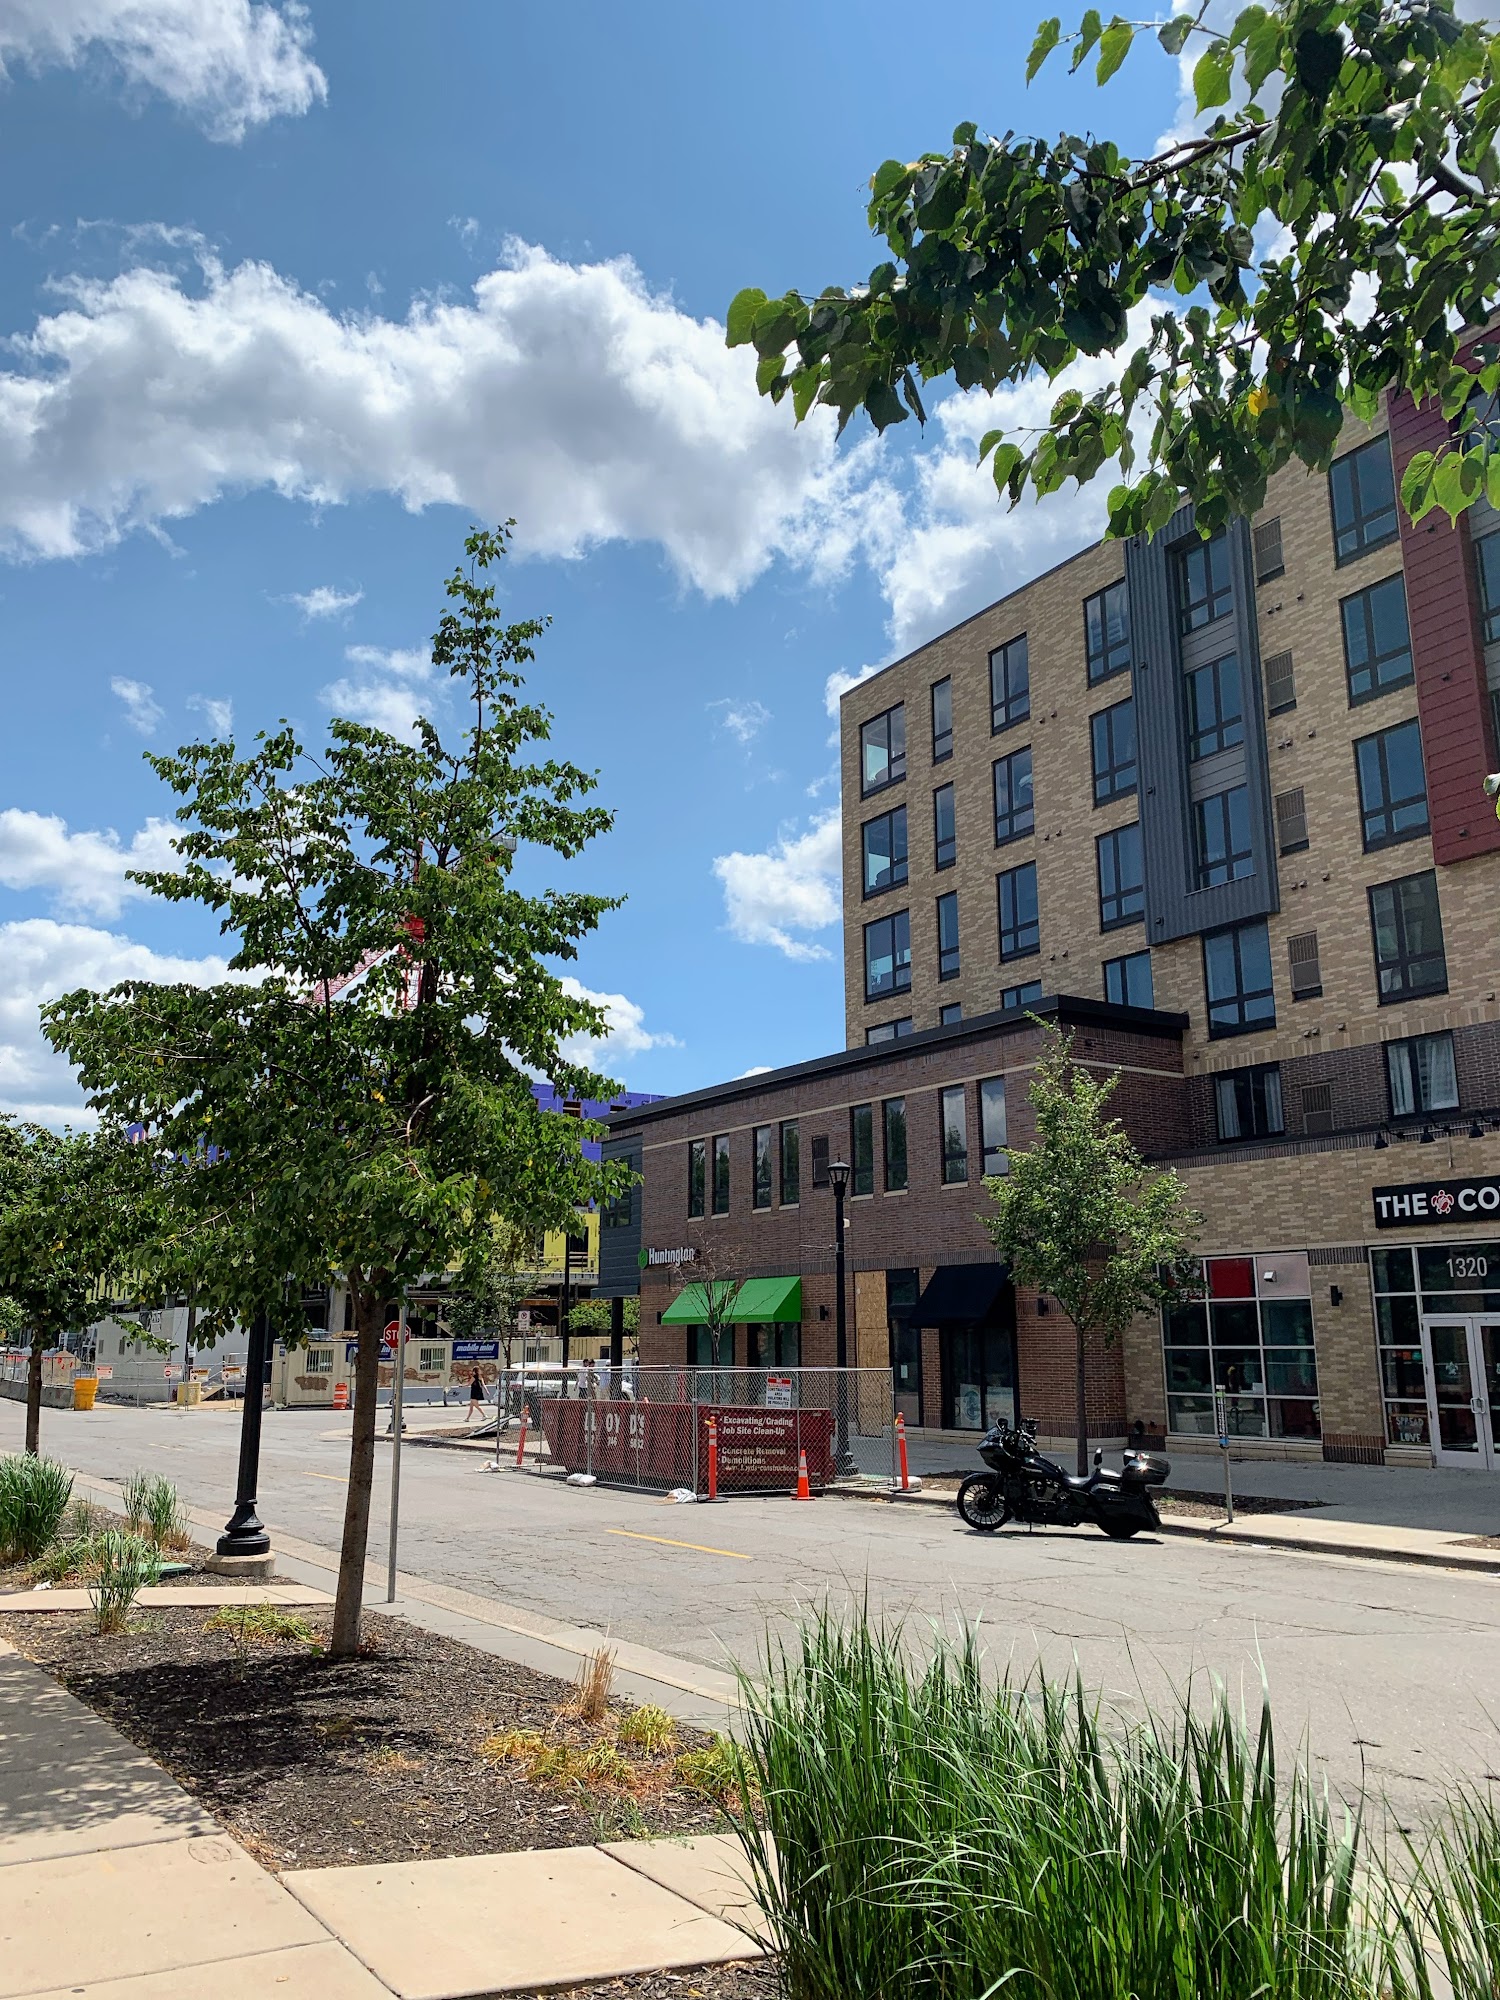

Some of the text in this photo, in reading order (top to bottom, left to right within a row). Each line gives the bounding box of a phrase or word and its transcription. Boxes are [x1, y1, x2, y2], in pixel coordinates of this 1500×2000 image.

[1376, 1186, 1500, 1218] THE CO
[649, 1247, 694, 1267] Huntington
[1446, 1257, 1488, 1278] 1320
[385, 1330, 409, 1341] STP
[456, 1343, 495, 1352] mobile mini
[723, 1416, 794, 1427] Excavating/Grading
[1396, 1416, 1424, 1427] SPREAD
[722, 1427, 785, 1436] Job Site Clean-Up
[1400, 1432, 1421, 1443] LOVE
[722, 1447, 755, 1455] Concrete
[722, 1456, 766, 1465] Demolitions
